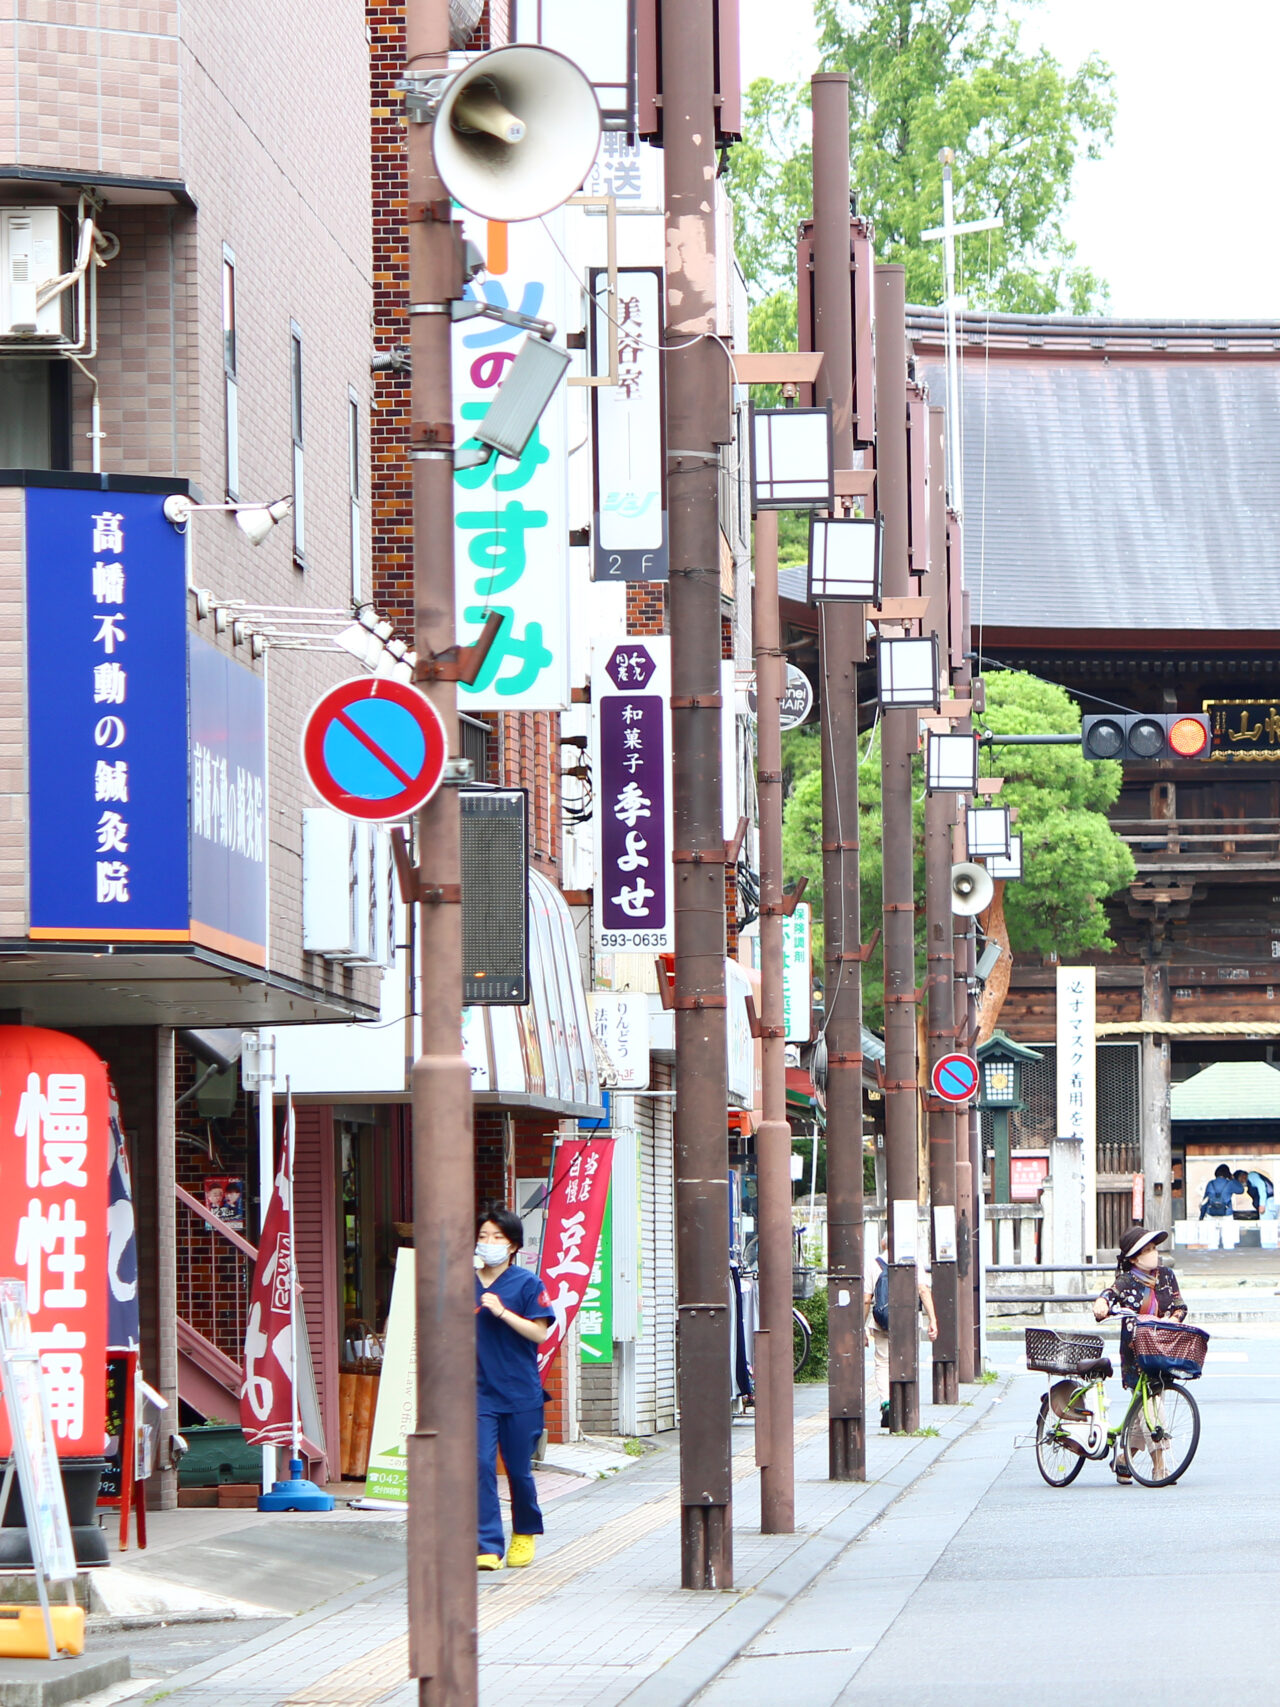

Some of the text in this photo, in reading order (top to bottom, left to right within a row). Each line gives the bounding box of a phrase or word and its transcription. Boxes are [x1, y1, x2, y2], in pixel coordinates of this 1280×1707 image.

[91, 511, 129, 903] 高幡不動の鍼灸院
[620, 703, 644, 774] 和菓子
[611, 781, 655, 918] 季よせ
[600, 933, 668, 947] 593-0635
